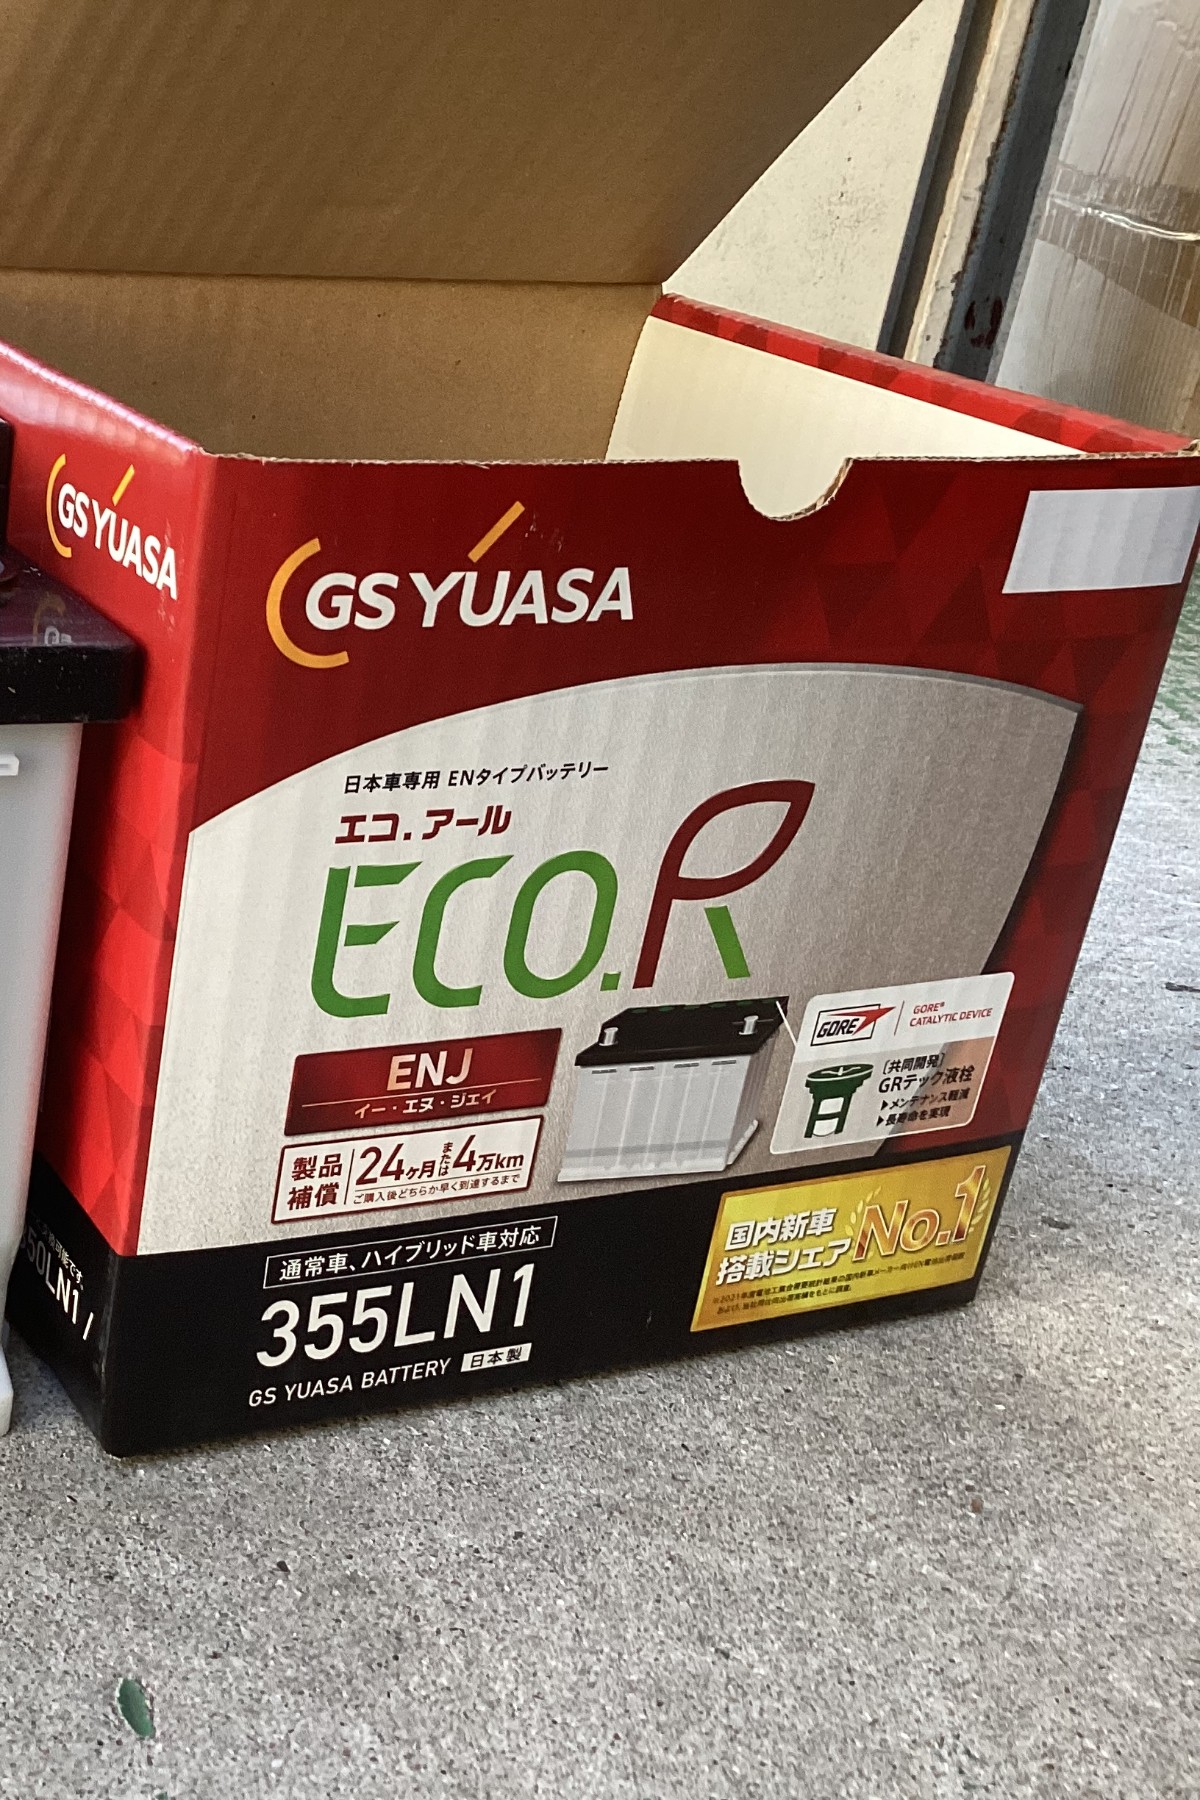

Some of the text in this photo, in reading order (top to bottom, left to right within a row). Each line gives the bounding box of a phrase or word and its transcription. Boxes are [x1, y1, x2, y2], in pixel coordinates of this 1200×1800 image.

[58, 483, 178, 601] GS YUASA
[305, 567, 634, 631] GS YUASA
[343, 761, 609, 795] 日本車専用 ENタイプバッテリー
[311, 779, 816, 1018] ECO.R
[816, 1018, 860, 1039] GORE
[909, 1007, 993, 1028] CATALYTIC DEVICE
[387, 1048, 473, 1091] ENJ
[878, 1064, 975, 1093] GRテック液栓
[292, 1153, 343, 1181] 製品
[287, 1182, 340, 1212] 補償
[353, 1173, 522, 1206] ご購入後どちらか早く到達するまで
[715, 1236, 851, 1287] 搭載シェア
[851, 1164, 986, 1263] No.1
[724, 1207, 838, 1251] 国内新車
[279, 1225, 542, 1283] 通常車、ハイブリッド車対応
[256, 1263, 535, 1369] 355LN1
[469, 1346, 522, 1369] 日本製
[248, 1358, 452, 1408] GS YUASA BATTERY
